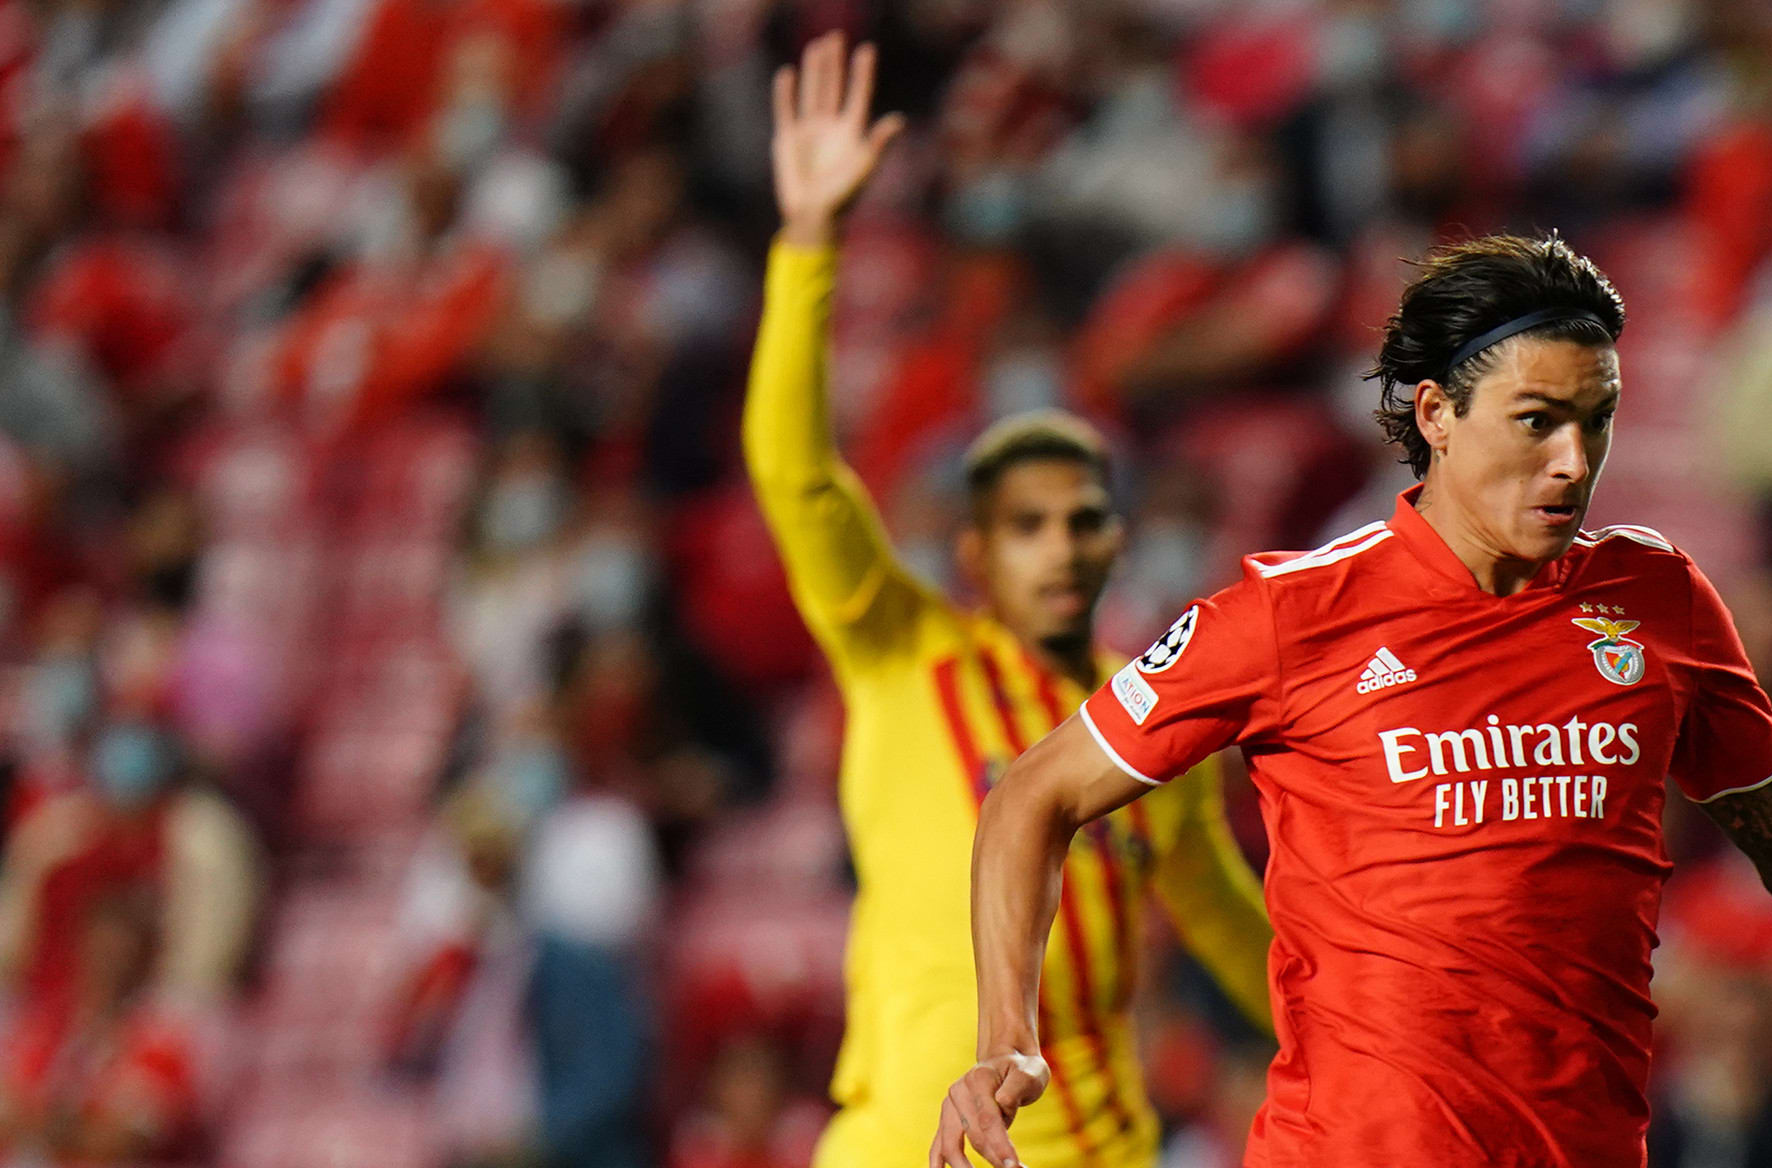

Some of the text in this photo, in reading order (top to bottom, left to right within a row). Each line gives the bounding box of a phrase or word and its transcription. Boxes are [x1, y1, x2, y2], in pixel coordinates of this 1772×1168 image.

[1356, 668, 1418, 695] adidas
[1378, 714, 1641, 784] Emirates
[1433, 775, 1608, 828] FLY BETTER
